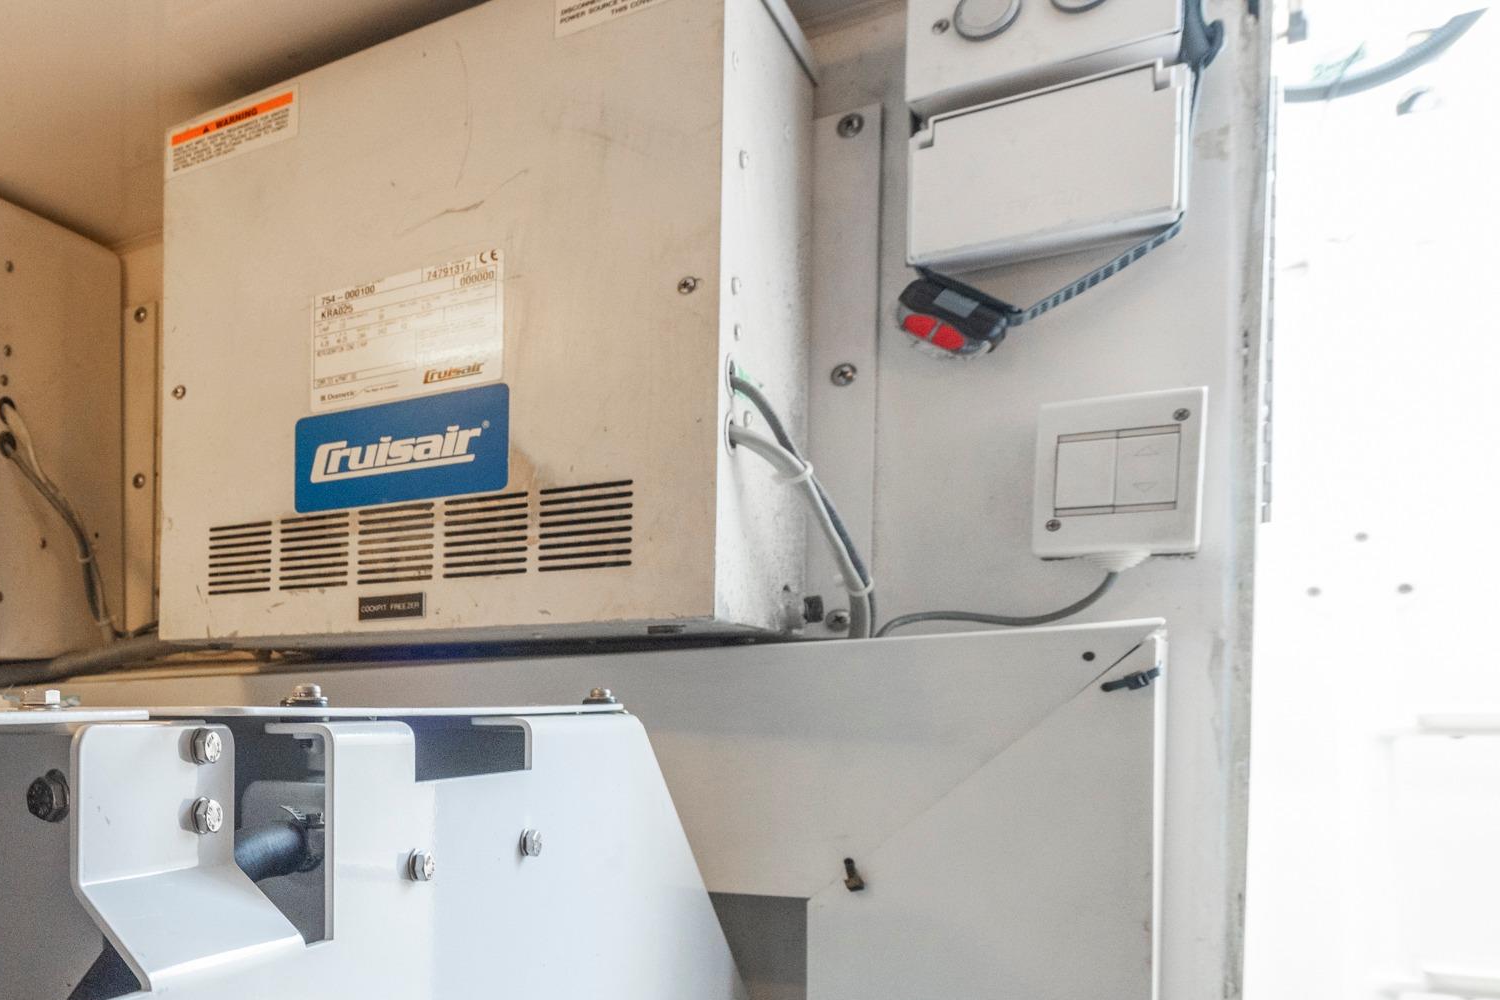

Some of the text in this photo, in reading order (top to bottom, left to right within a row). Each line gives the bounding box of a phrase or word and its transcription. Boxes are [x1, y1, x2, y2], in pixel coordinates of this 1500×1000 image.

[215, 107, 258, 129] WARNING
[423, 361, 485, 384] Cruisair
[310, 424, 483, 484] Cruisair
